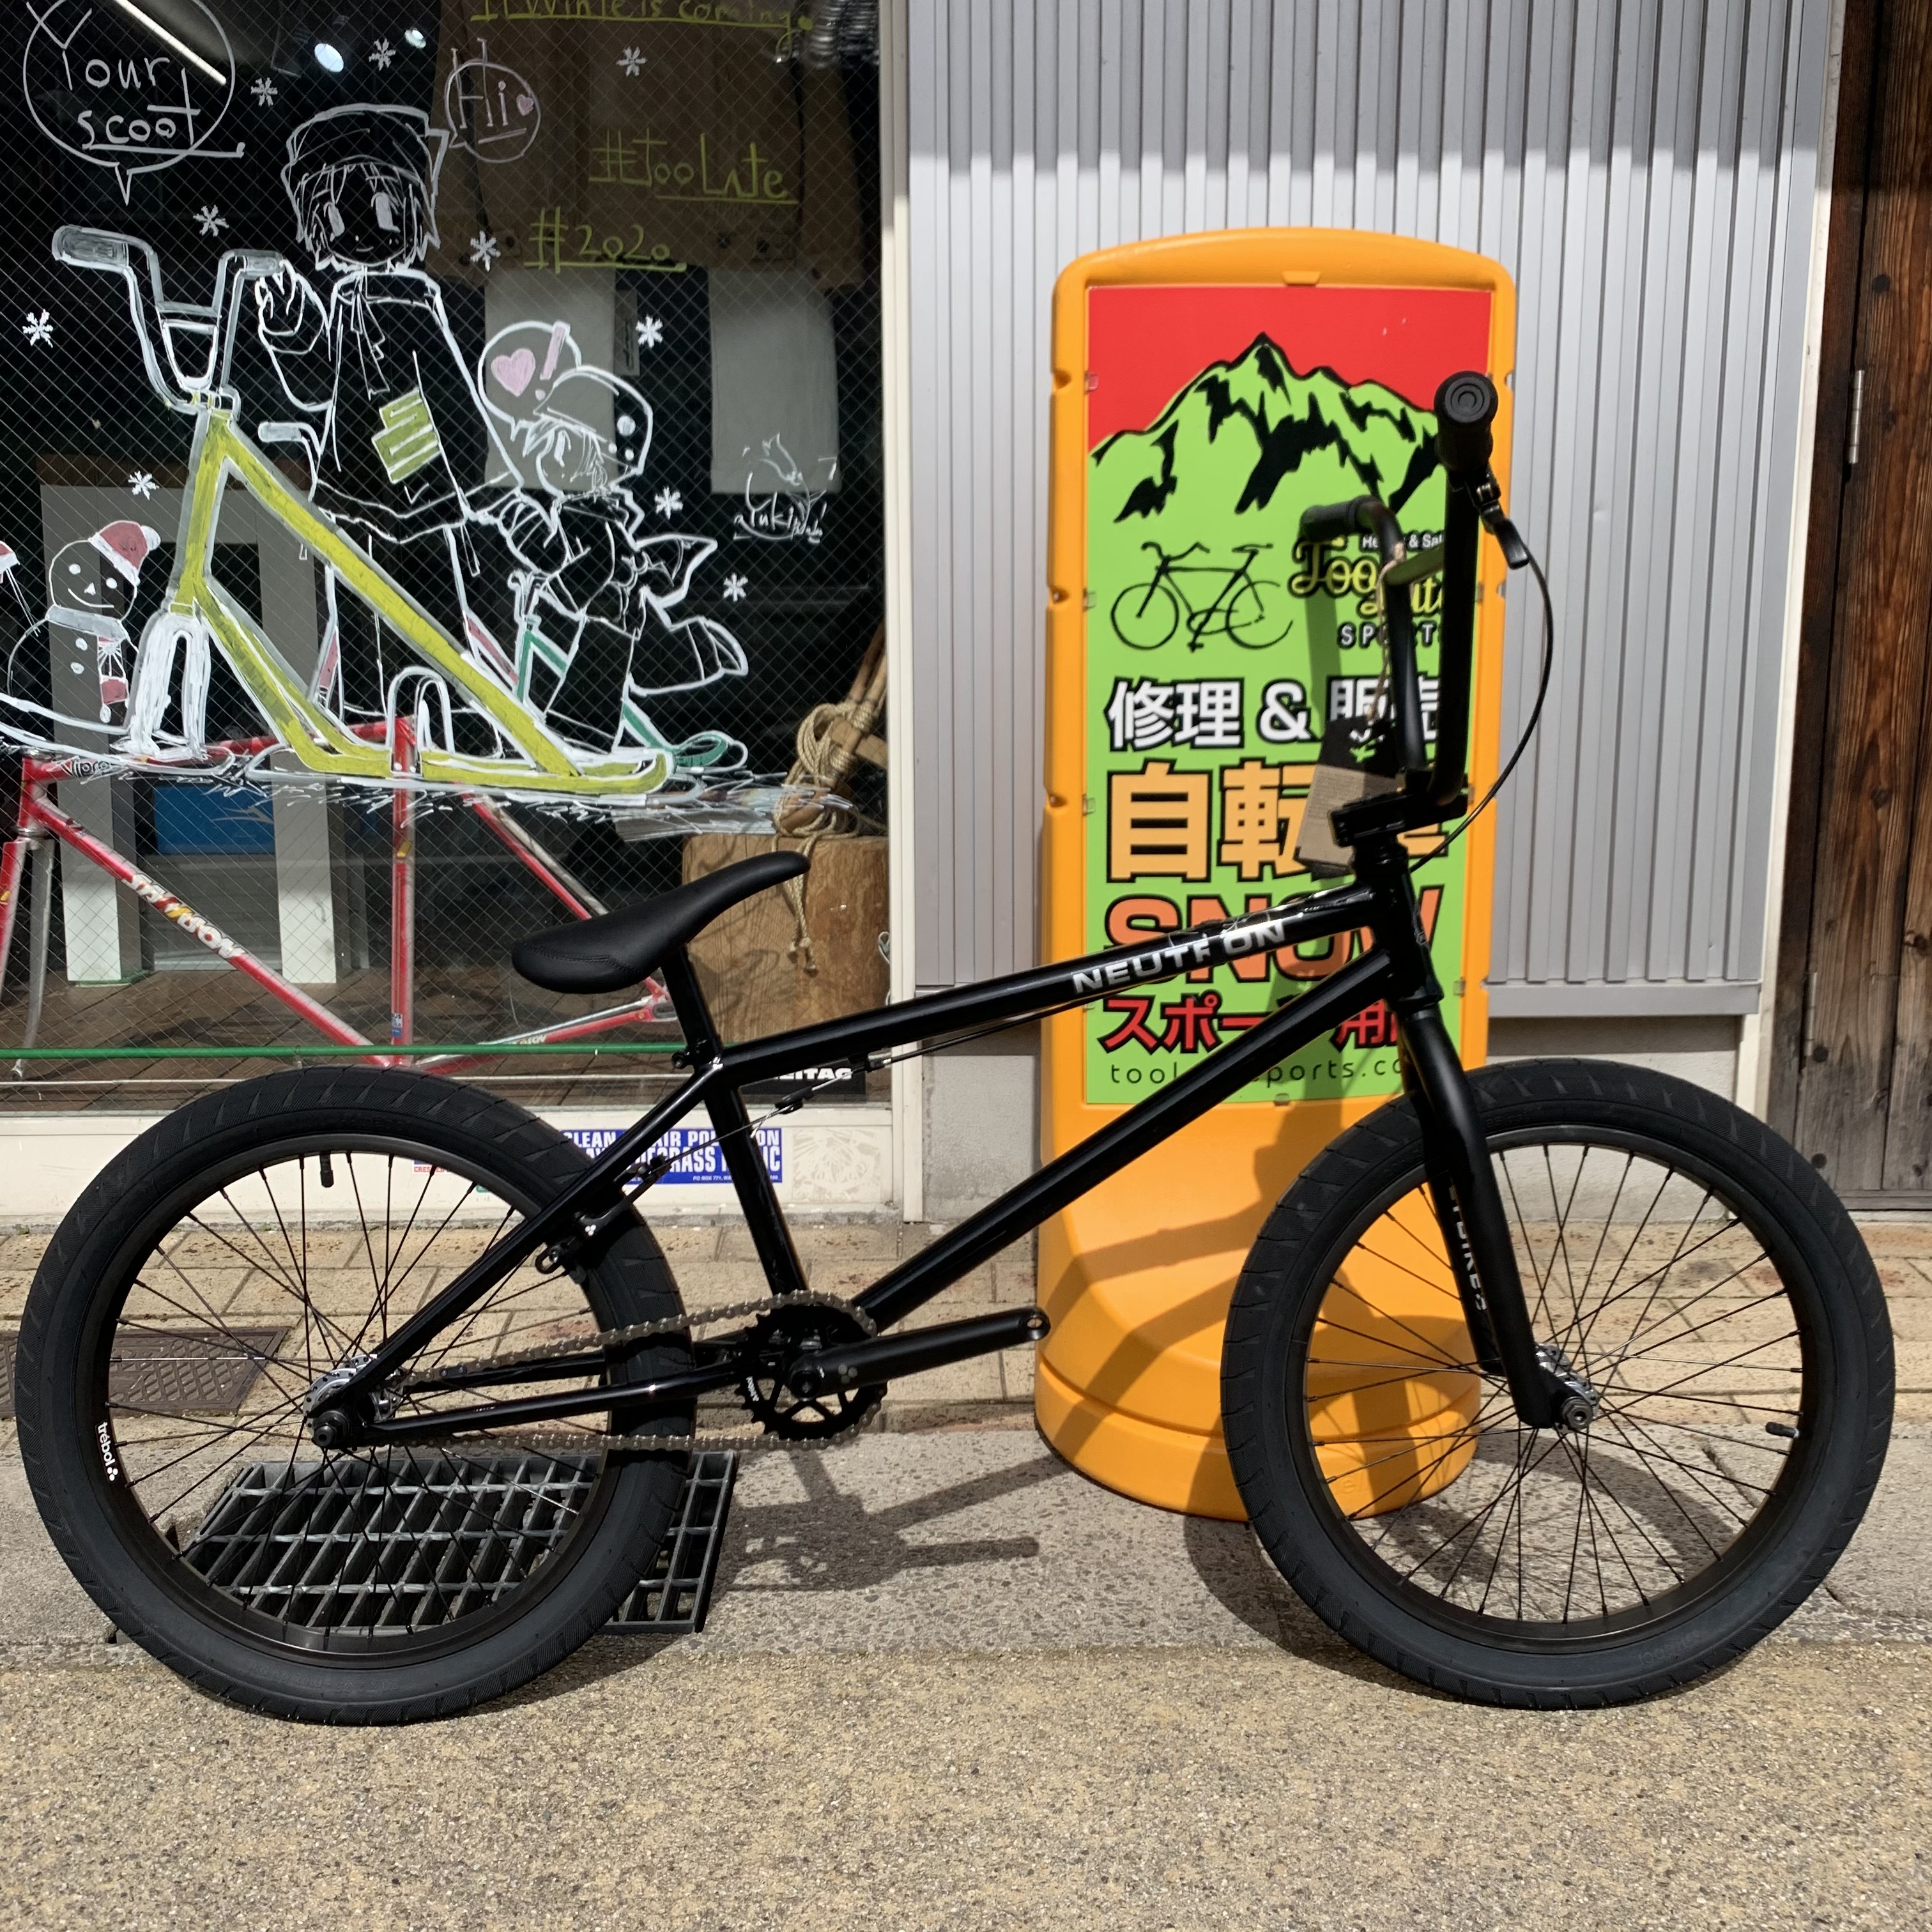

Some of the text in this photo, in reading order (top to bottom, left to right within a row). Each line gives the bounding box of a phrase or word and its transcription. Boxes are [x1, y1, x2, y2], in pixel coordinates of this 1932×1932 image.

[27, 2, 170, 90] Your
[452, 38, 509, 128] Hi
[77, 68, 201, 150] scoot
[1107, 680, 1241, 750] 修理
[1260, 682, 1311, 741] &
[98, 1422, 116, 1467] trébol
